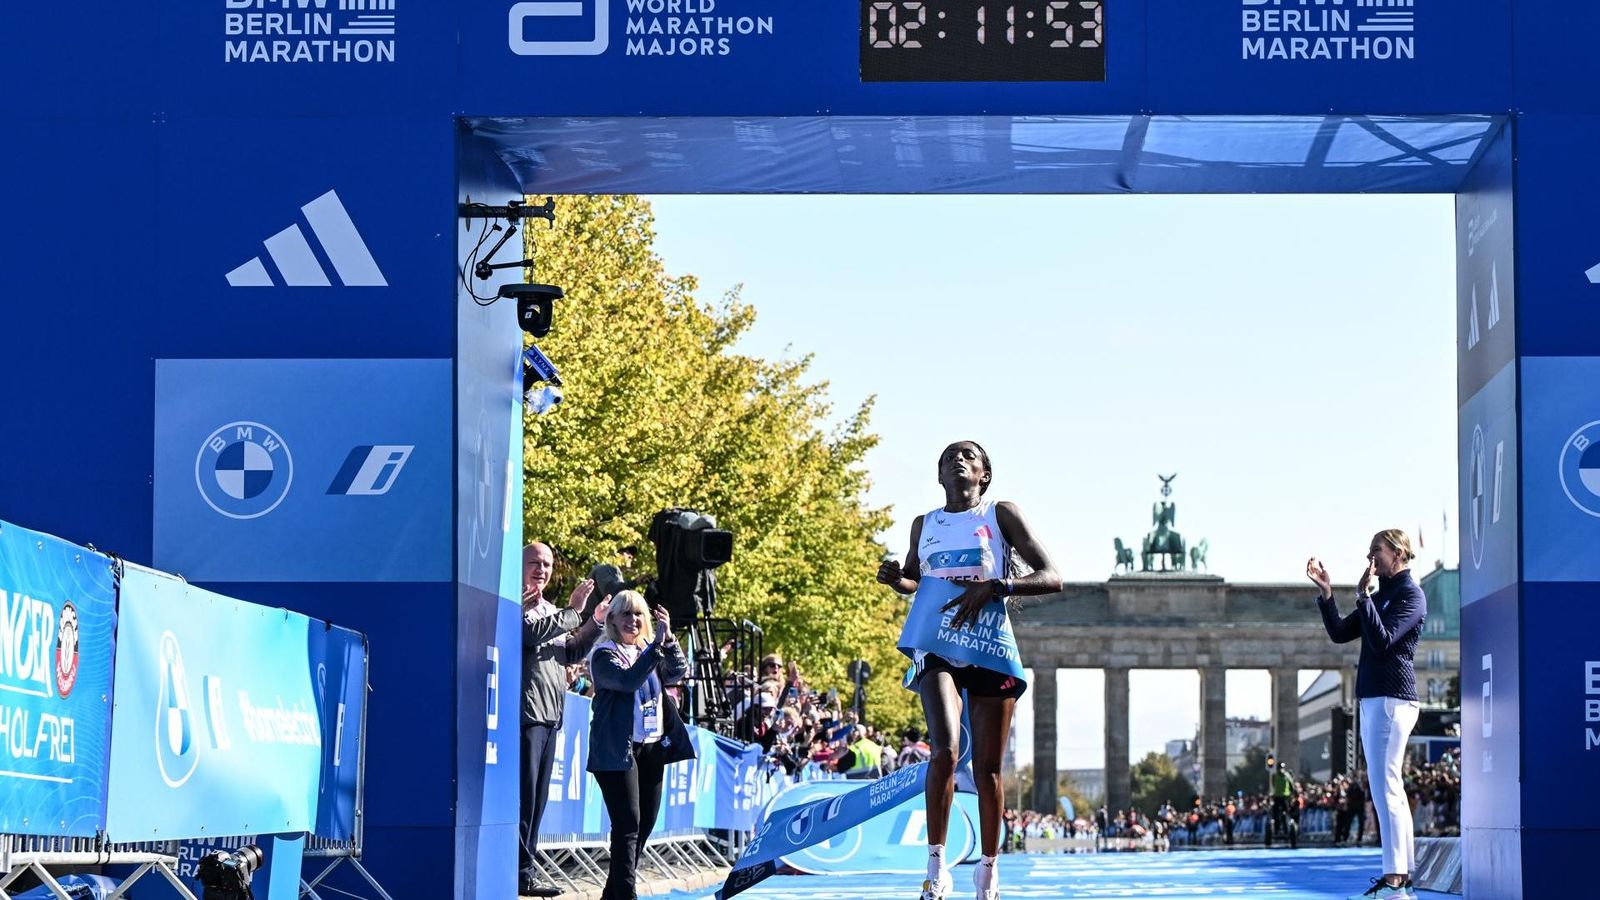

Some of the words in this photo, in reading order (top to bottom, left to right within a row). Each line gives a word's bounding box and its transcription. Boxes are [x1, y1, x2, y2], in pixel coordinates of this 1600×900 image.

[625, 0, 715, 13] WORLD
[225, 13, 332, 35] BERLIN
[625, 16, 773, 35] MARATHON
[1242, 9, 1350, 32] BERLIN
[225, 40, 395, 62] MARATHON
[625, 37, 730, 56] MAJORS
[1242, 36, 1415, 60] MARATHON
[209, 426, 280, 453] BMW
[937, 629, 1013, 661] MARATHON
[870, 776, 898, 797] BERLIN
